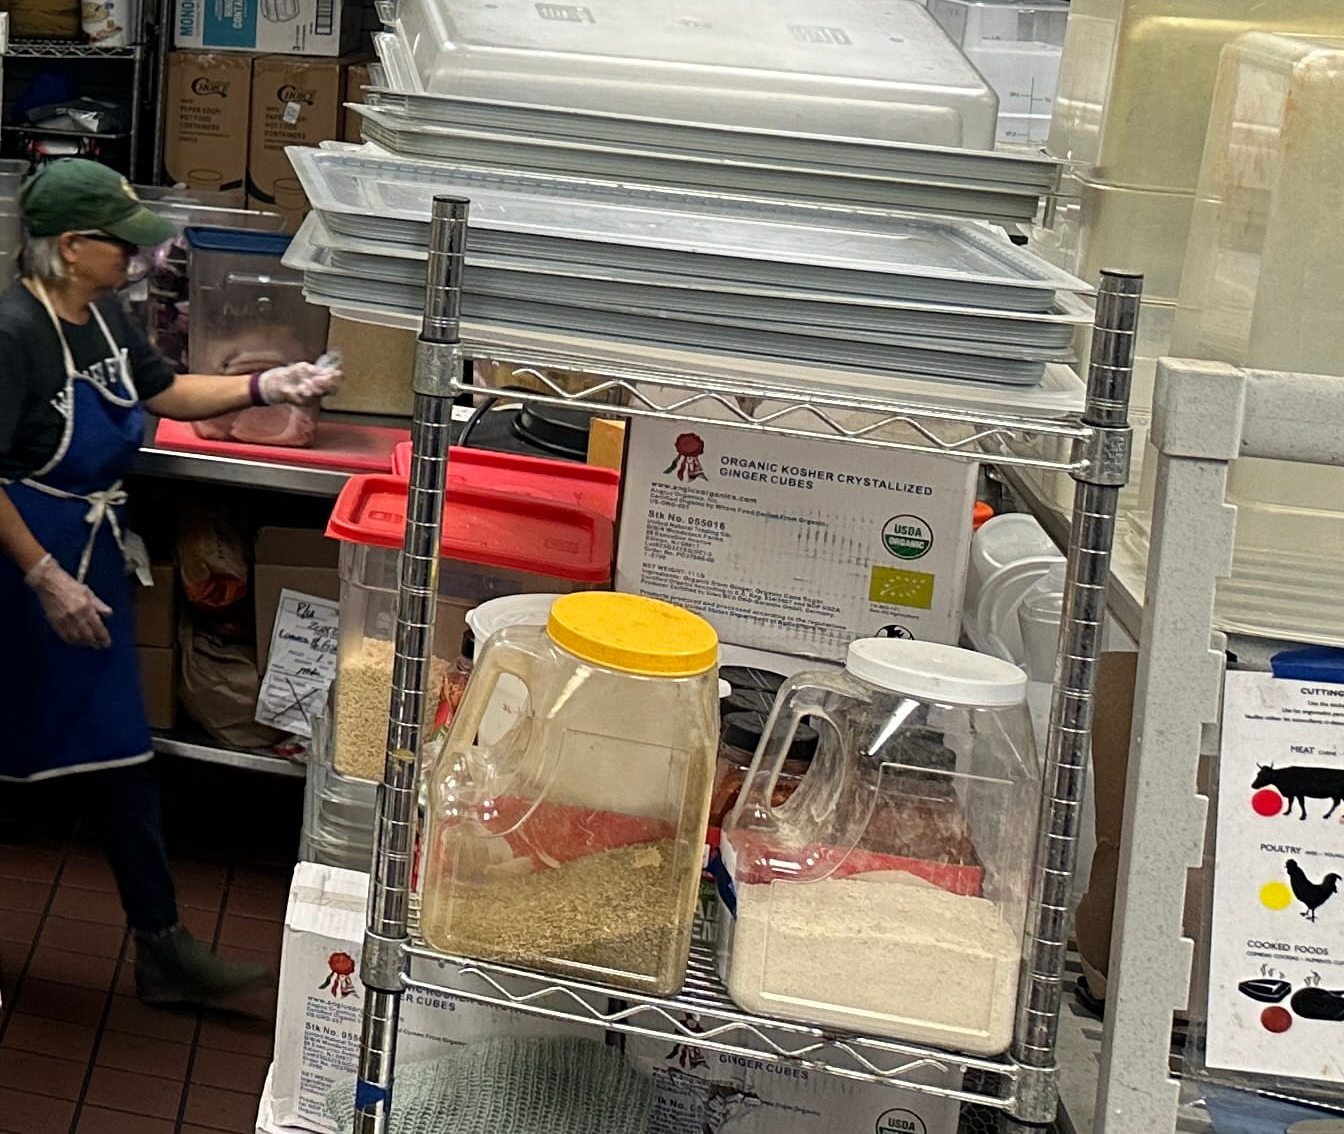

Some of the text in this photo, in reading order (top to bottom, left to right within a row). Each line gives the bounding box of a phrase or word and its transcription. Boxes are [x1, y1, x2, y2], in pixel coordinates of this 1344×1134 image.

[191, 77, 231, 98] CHOICE
[277, 84, 319, 106] CHOICE
[719, 467, 814, 490] GINGER CUBES
[720, 456, 933, 496] ORGANIC KOSHER CRYSTALLIZED
[648, 510, 726, 531] Stk No. 055016
[894, 523, 922, 537] USDA
[888, 536, 926, 550] ORGANIC
[1300, 687, 1344, 697] CUTTING
[1290, 746, 1315, 754] MEAT
[1260, 843, 1302, 854] POULTRY
[1247, 939, 1329, 955] COOKED FOODS
[415, 997, 457, 1012] CUBES
[305, 1022, 321, 1032] Stk
[719, 1054, 810, 1080] GINGER CUBES
[887, 1118, 916, 1132] USDA
